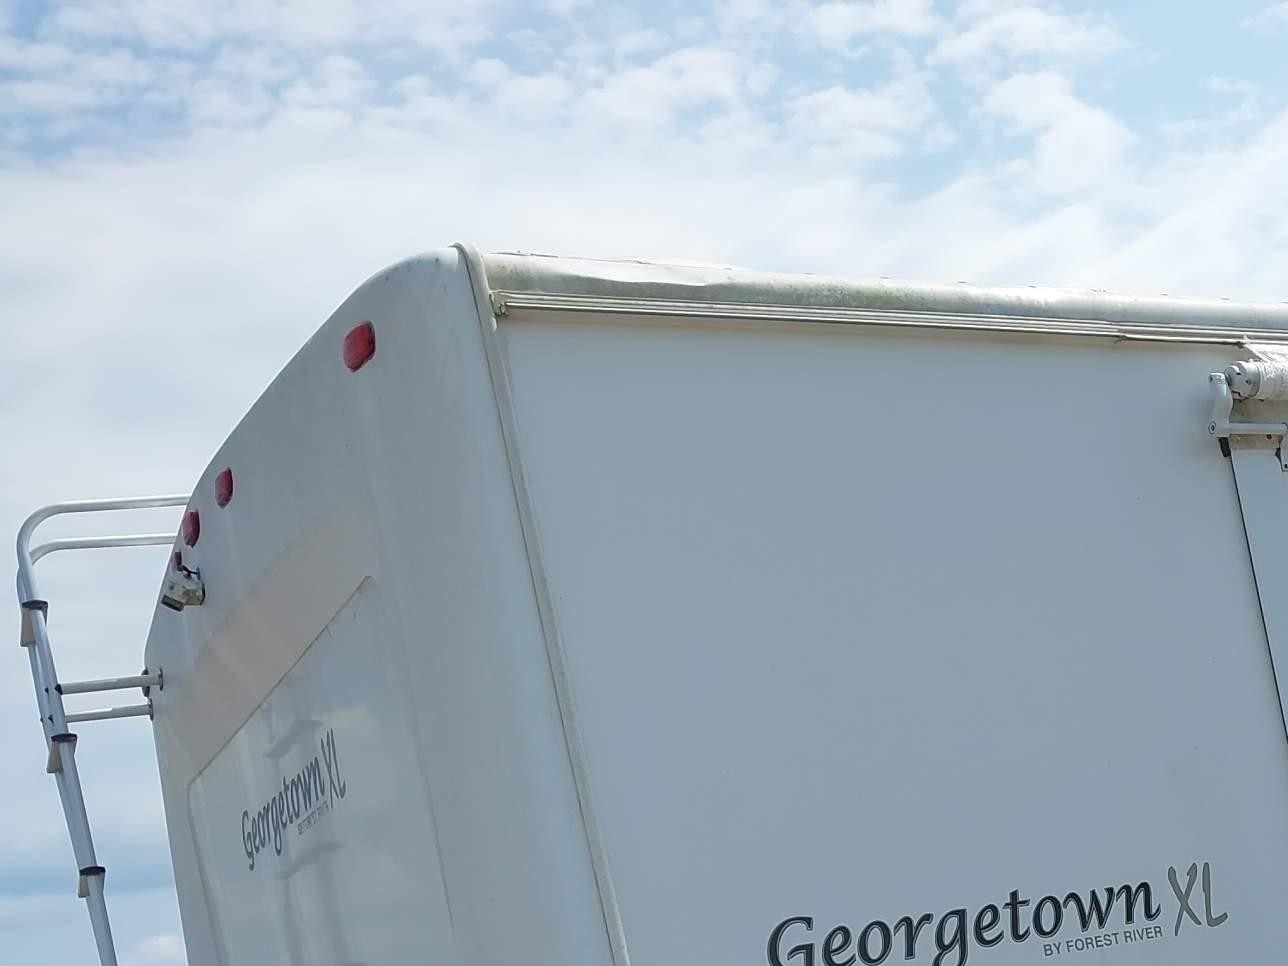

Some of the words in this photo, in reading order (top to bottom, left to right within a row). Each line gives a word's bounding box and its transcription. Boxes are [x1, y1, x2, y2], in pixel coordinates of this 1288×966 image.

[242, 756, 325, 871] Georgetown
[320, 728, 346, 811] XL
[1167, 861, 1228, 937] XL
[1043, 942, 1062, 957] BY
[1066, 932, 1120, 953] FOREST
[1123, 925, 1163, 944] RIVER
